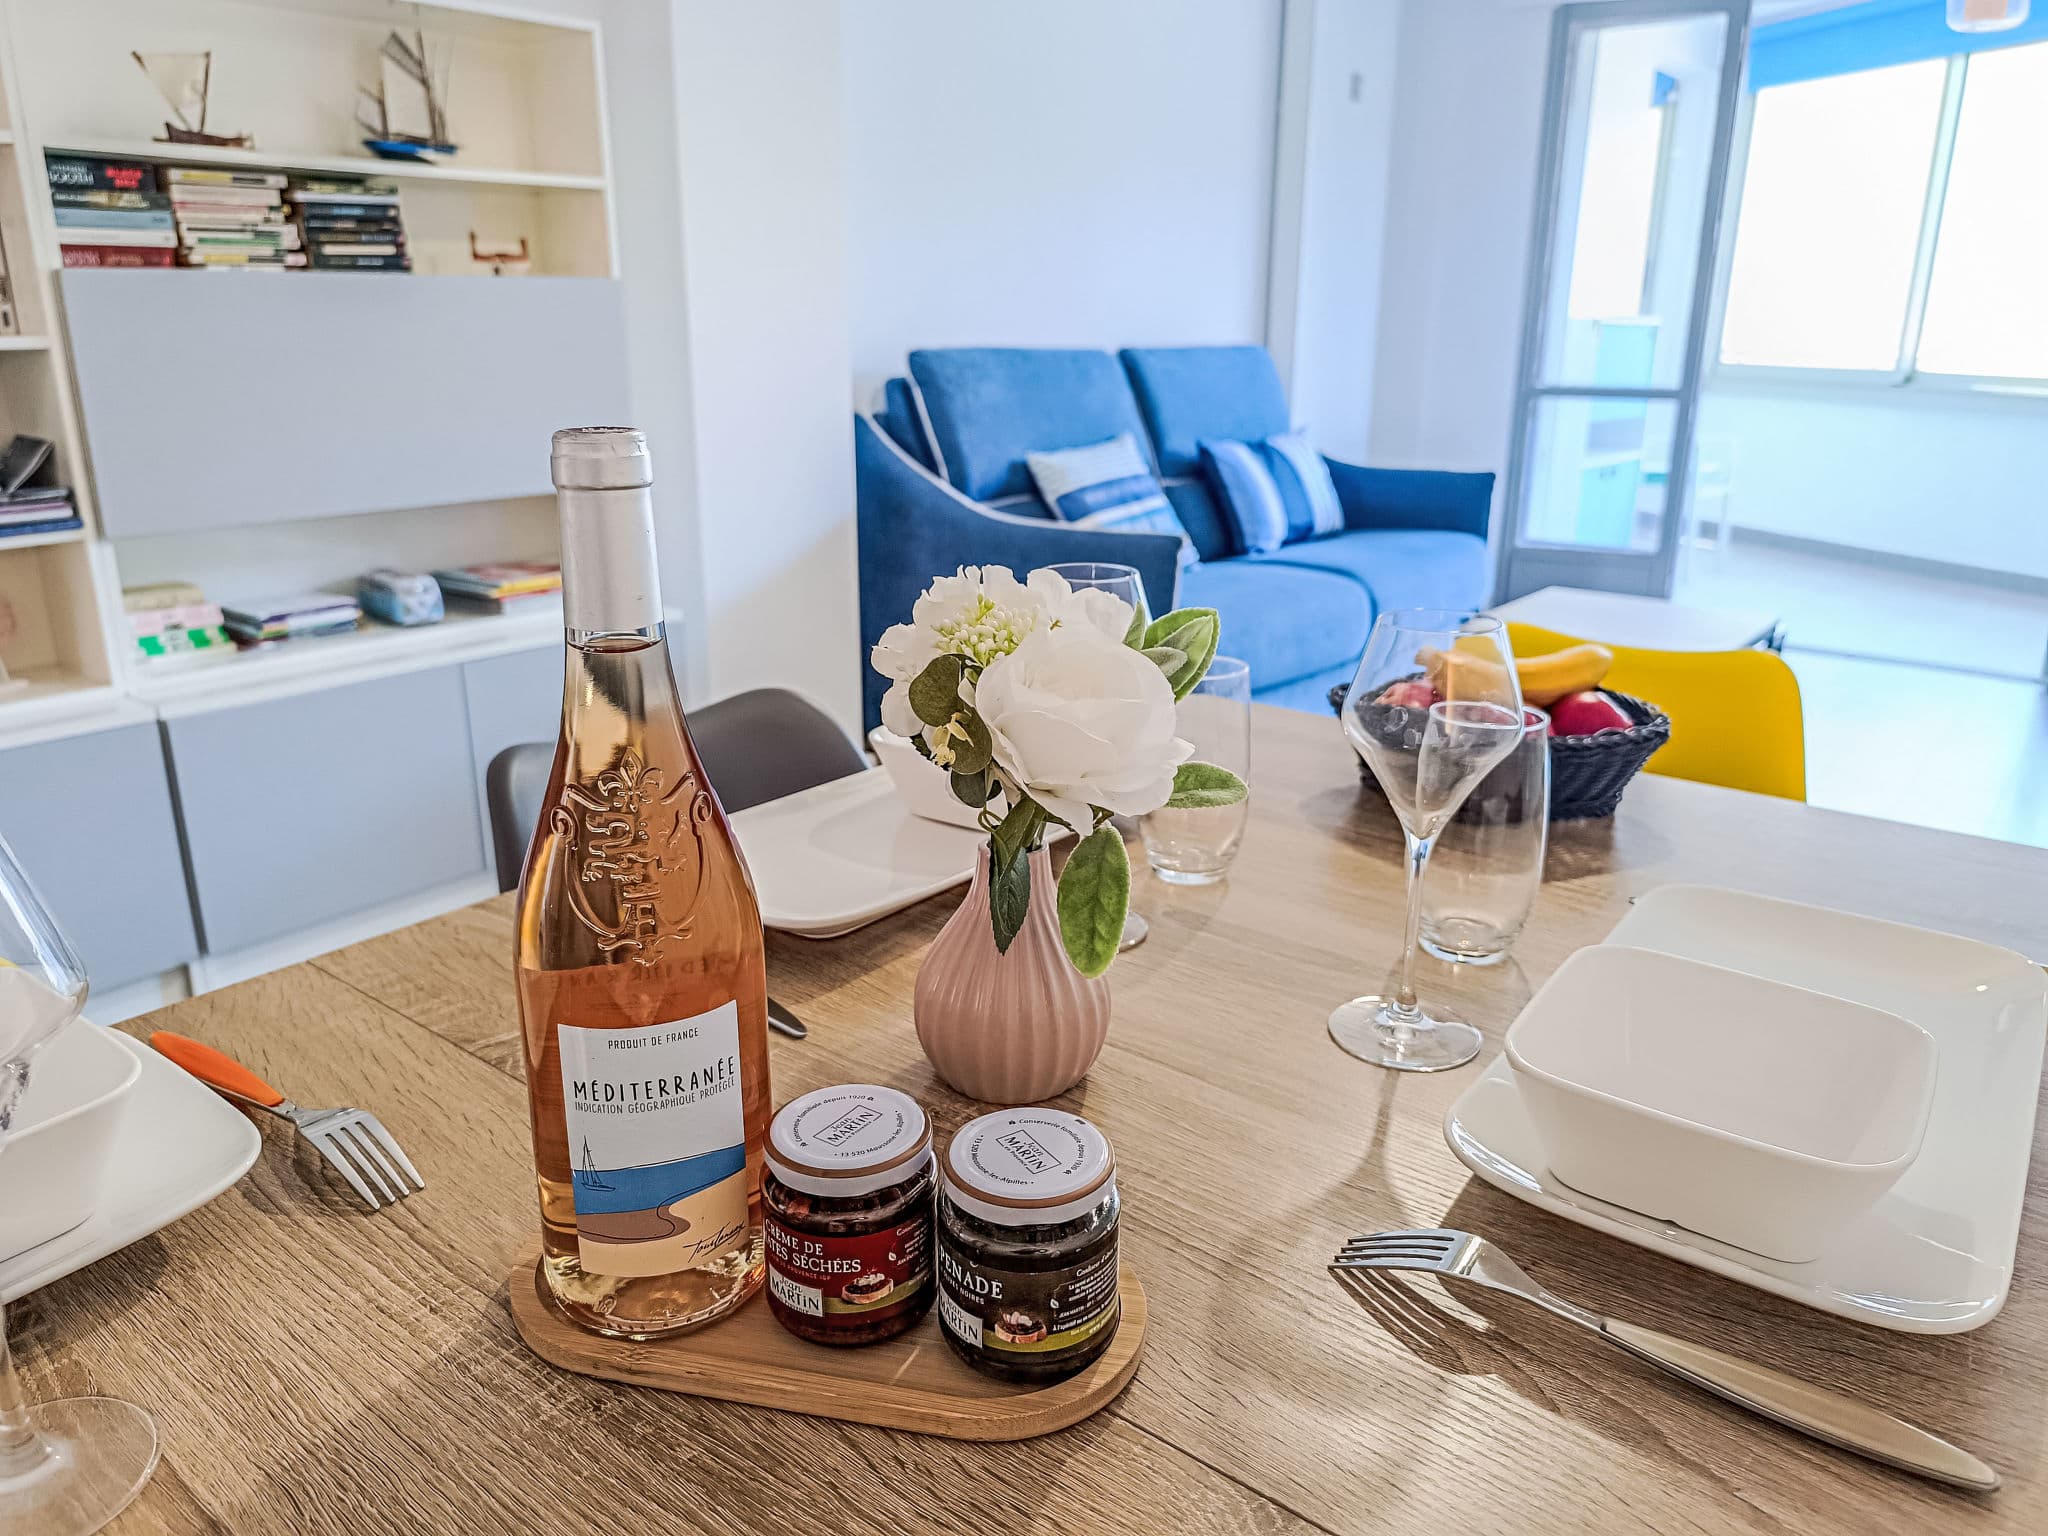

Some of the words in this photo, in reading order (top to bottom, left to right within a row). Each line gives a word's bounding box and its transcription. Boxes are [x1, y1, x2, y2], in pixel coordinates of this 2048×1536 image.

[608, 1038, 647, 1050] PRODUIT
[651, 1035, 663, 1046] DE
[666, 1027, 699, 1043] FRANCE
[573, 1056, 734, 1102] MÉDITERRANÉE
[575, 1101, 623, 1114] INDICATION
[628, 1093, 696, 1114] GÉOGRAPHIQUE
[700, 1076, 735, 1099] PROTÉGÉE
[765, 1218, 799, 1250] CRÈME
[804, 1241, 824, 1256] DE
[792, 1253, 862, 1273] SÉCHÉES
